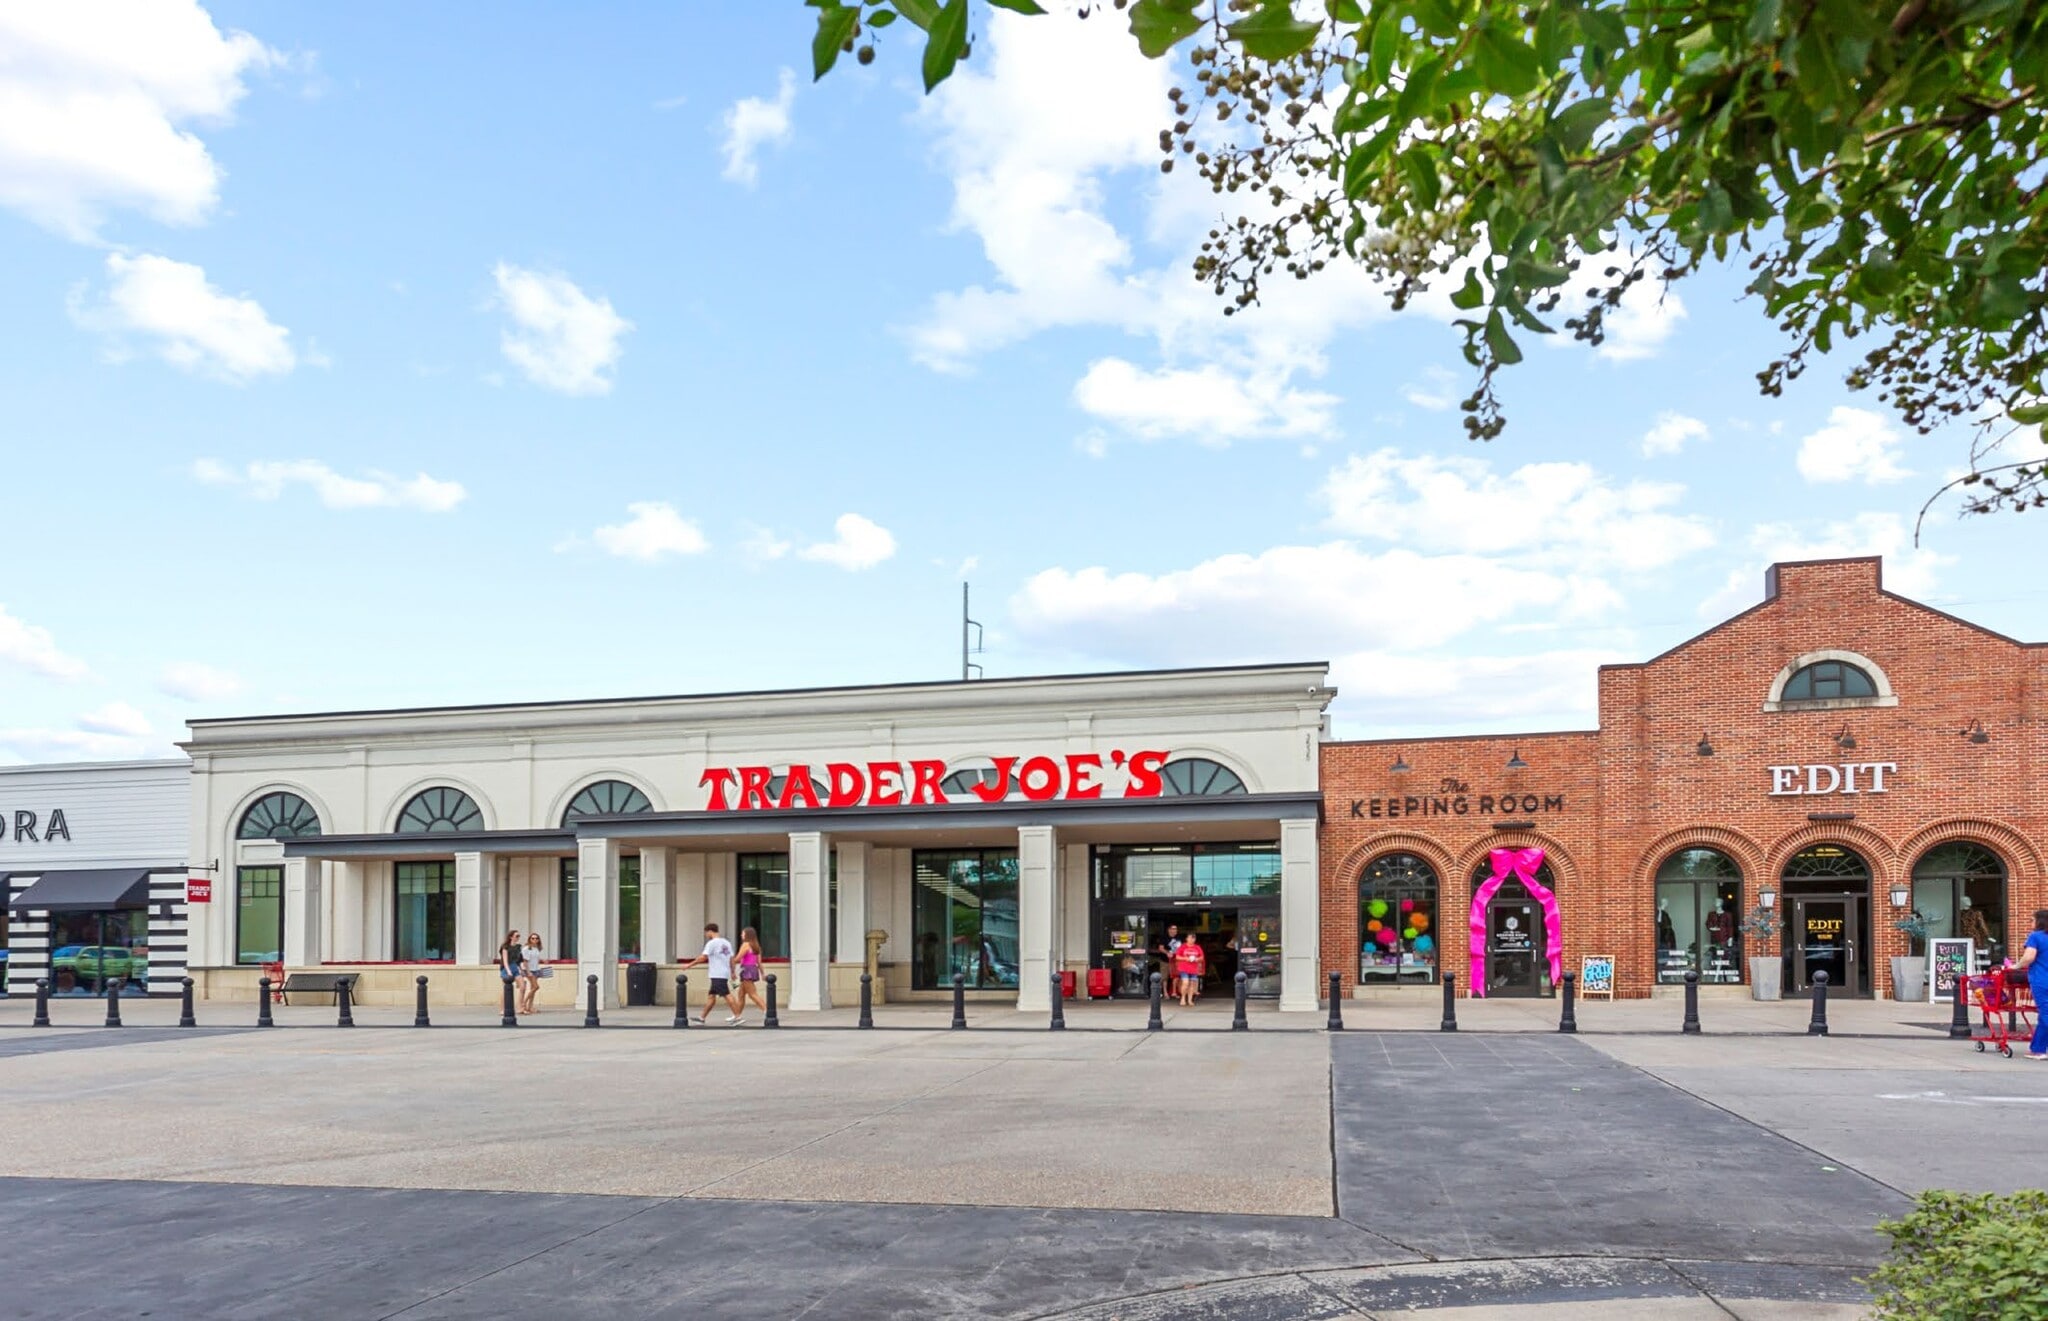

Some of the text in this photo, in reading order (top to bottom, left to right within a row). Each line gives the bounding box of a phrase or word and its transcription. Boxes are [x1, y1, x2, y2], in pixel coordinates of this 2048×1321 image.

[699, 750, 1170, 812] TRADER JOE'S
[1440, 777, 1469, 794] The
[1767, 762, 1897, 796] EDIT
[1351, 794, 1564, 818] KEEPING ROOM
[0, 808, 71, 843] RA
[1807, 919, 1843, 930] EDIT
